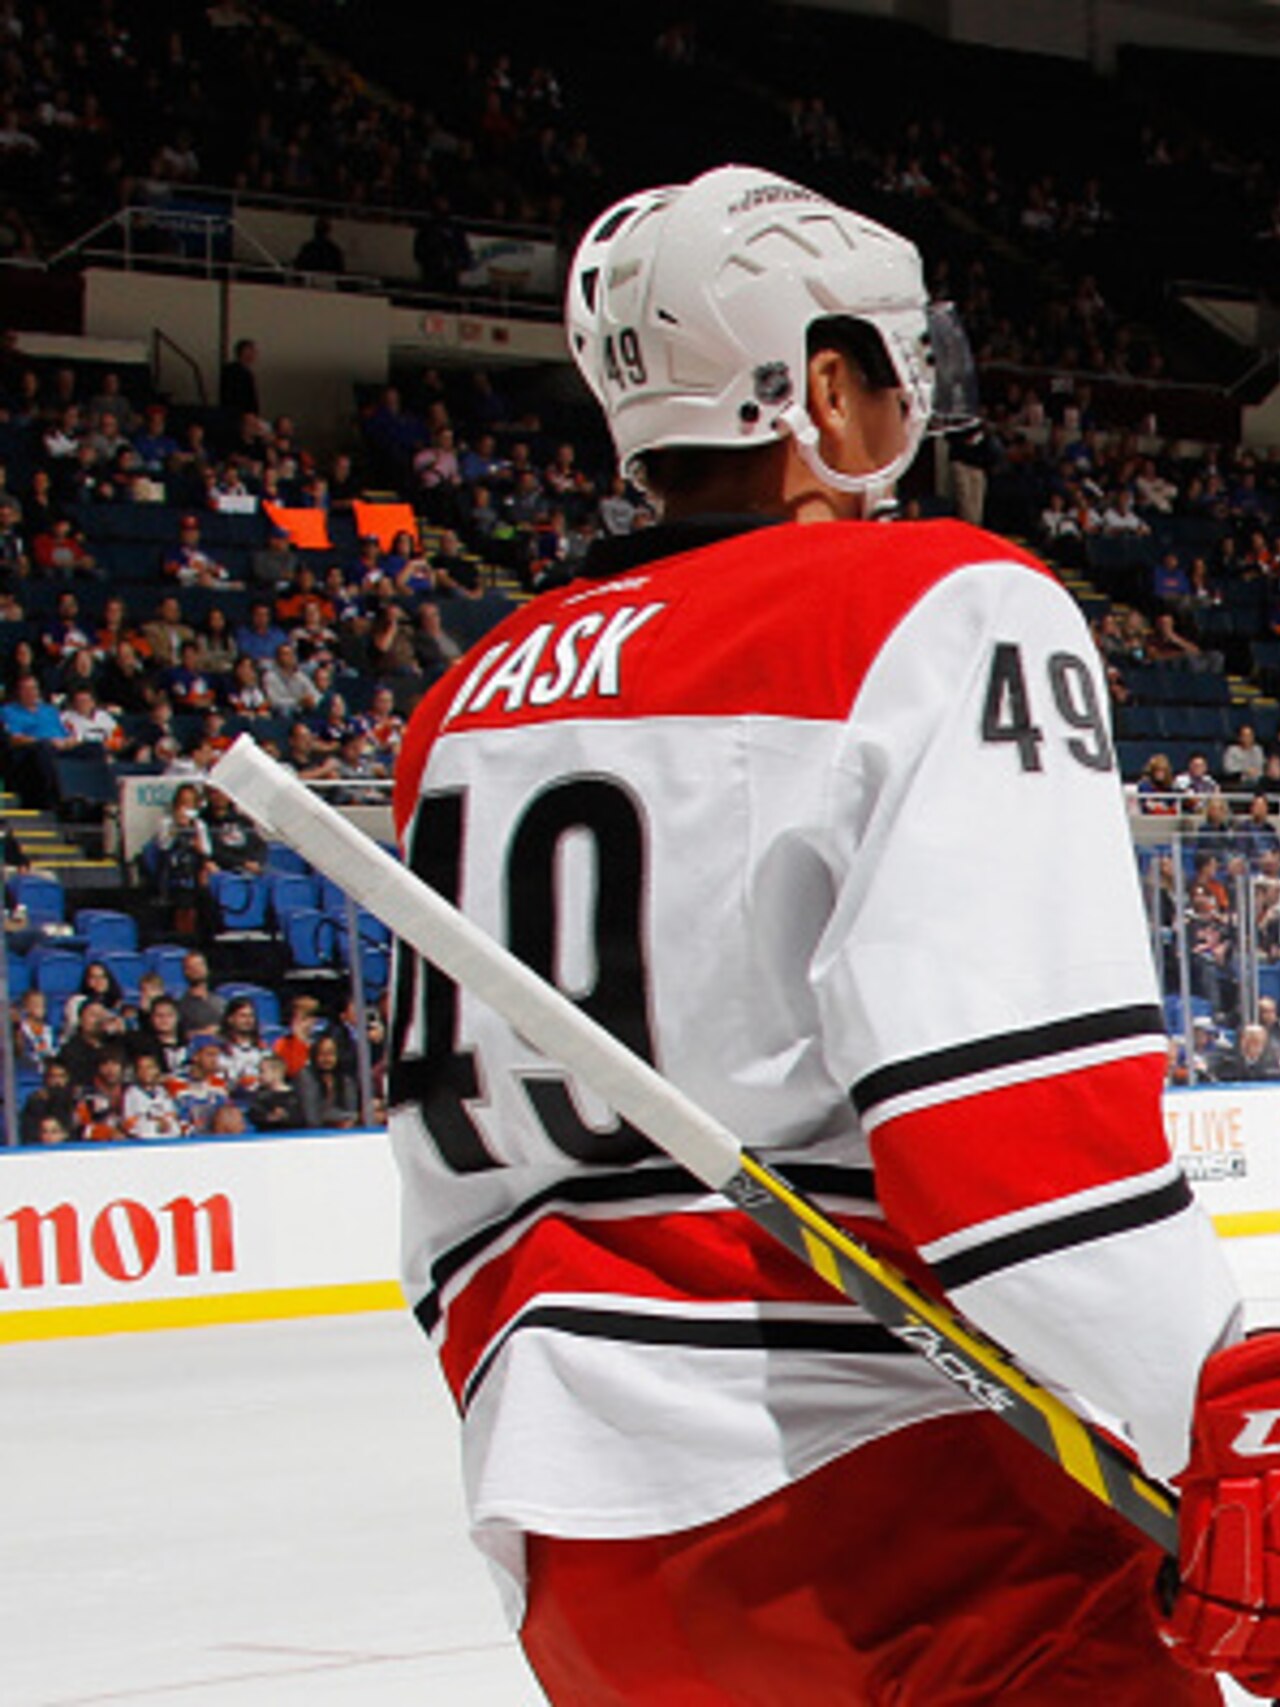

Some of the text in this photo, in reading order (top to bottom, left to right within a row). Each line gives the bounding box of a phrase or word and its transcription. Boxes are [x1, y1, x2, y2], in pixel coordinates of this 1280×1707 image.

[604, 326, 648, 391] 49
[980, 641, 1113, 773] 49
[386, 770, 661, 1177] 49
[1188, 1107, 1243, 1152] LIVE
[0, 1193, 235, 1291] non
